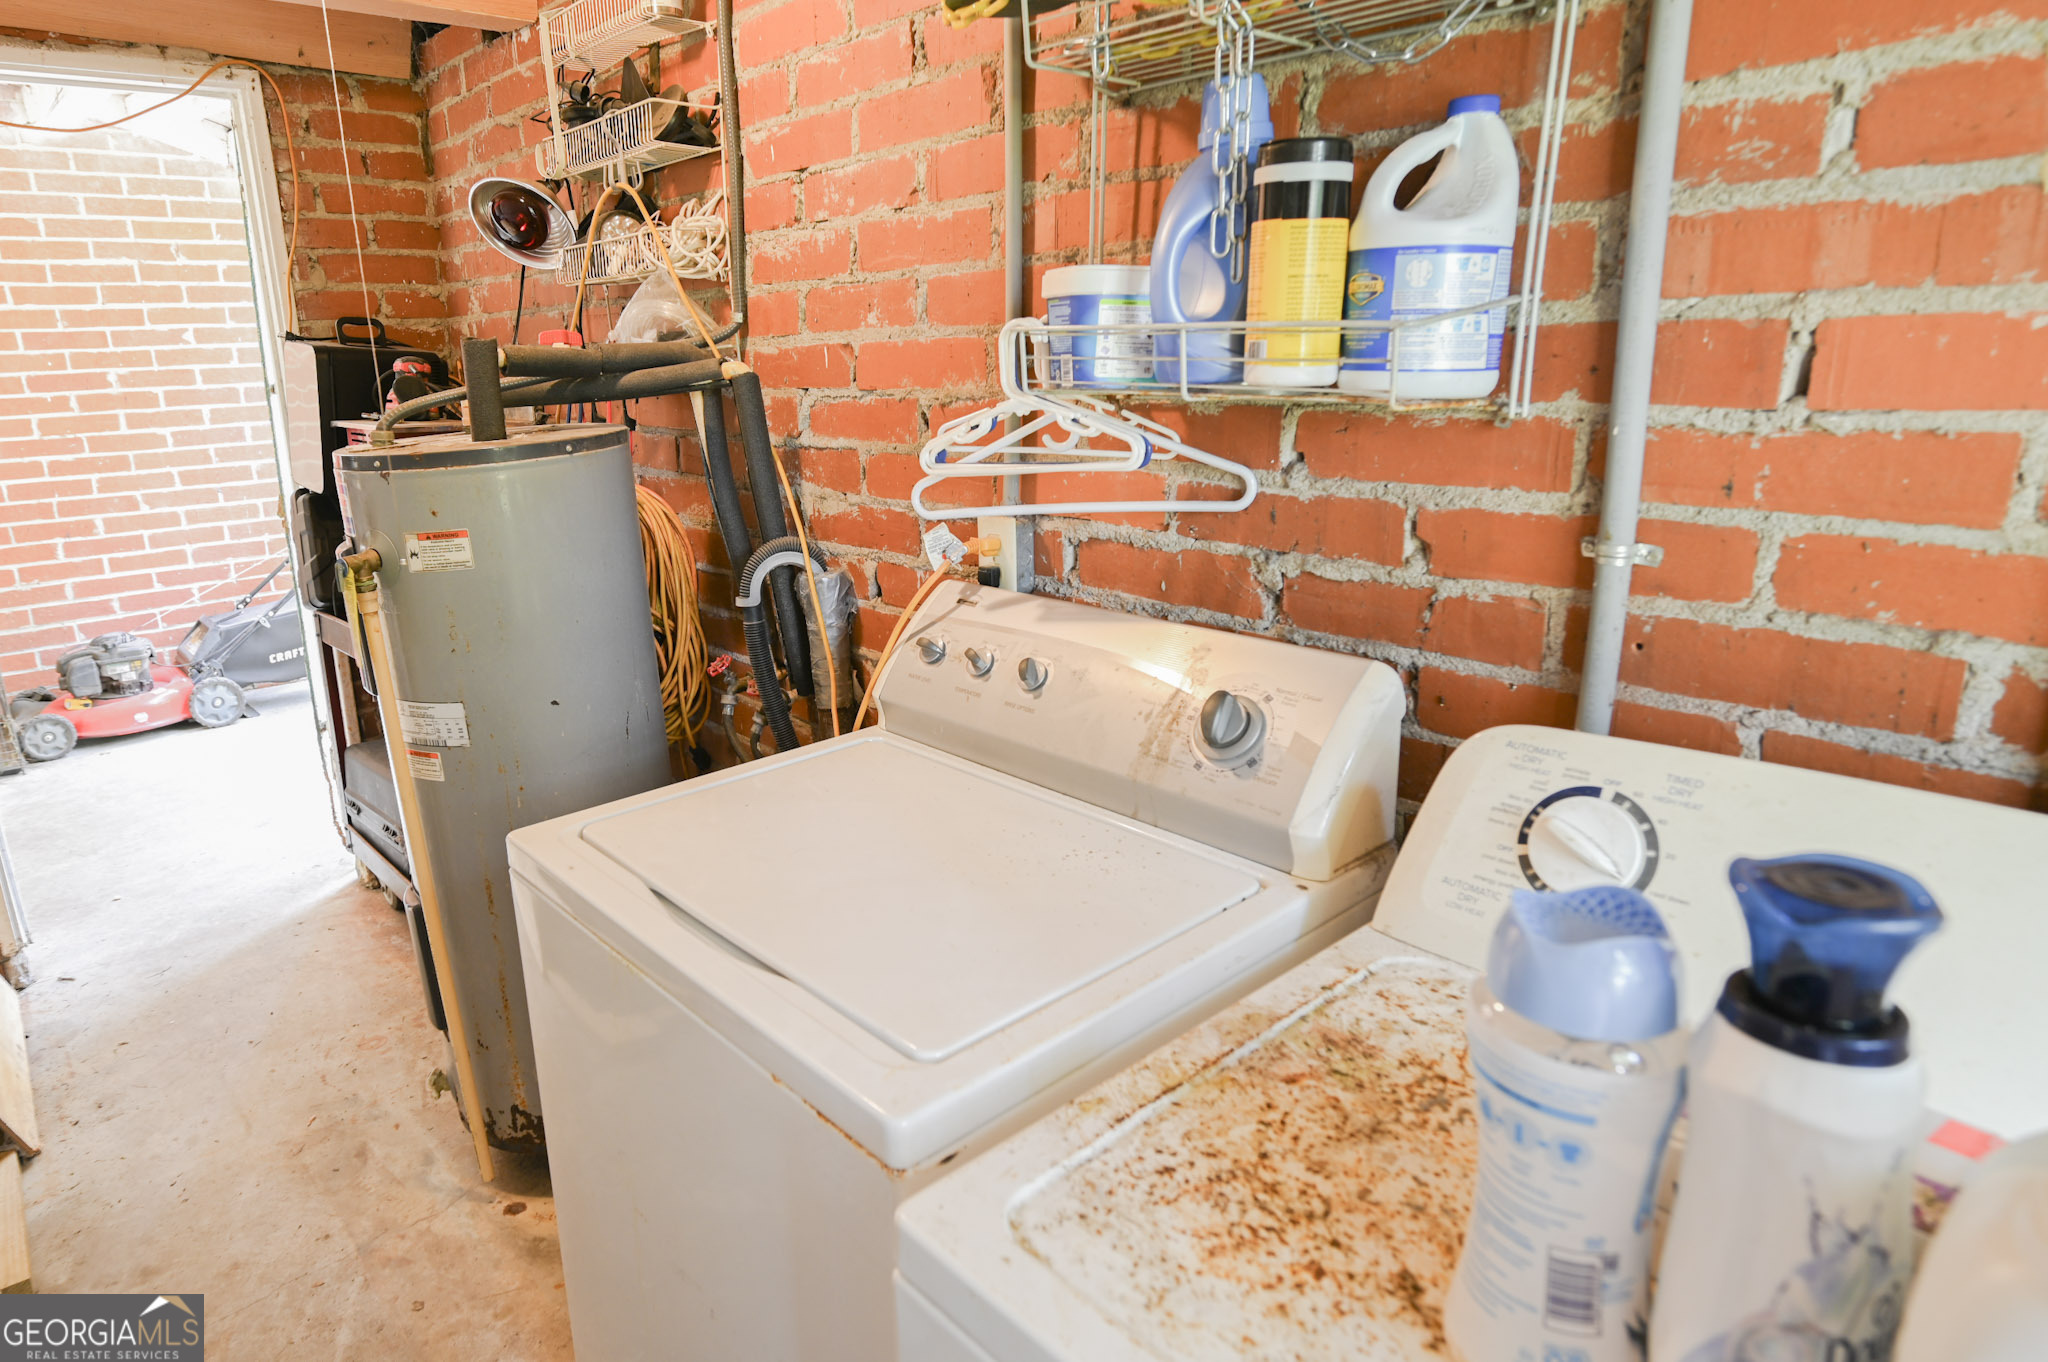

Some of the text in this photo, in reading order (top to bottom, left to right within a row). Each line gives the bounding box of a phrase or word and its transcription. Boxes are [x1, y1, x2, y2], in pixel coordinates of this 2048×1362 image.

[1505, 740, 1568, 760] AUTOMATIC
[1522, 754, 1544, 764] DRY
[1666, 773, 1705, 790] TIMED
[1441, 875, 1503, 902] AUTOMATIC
